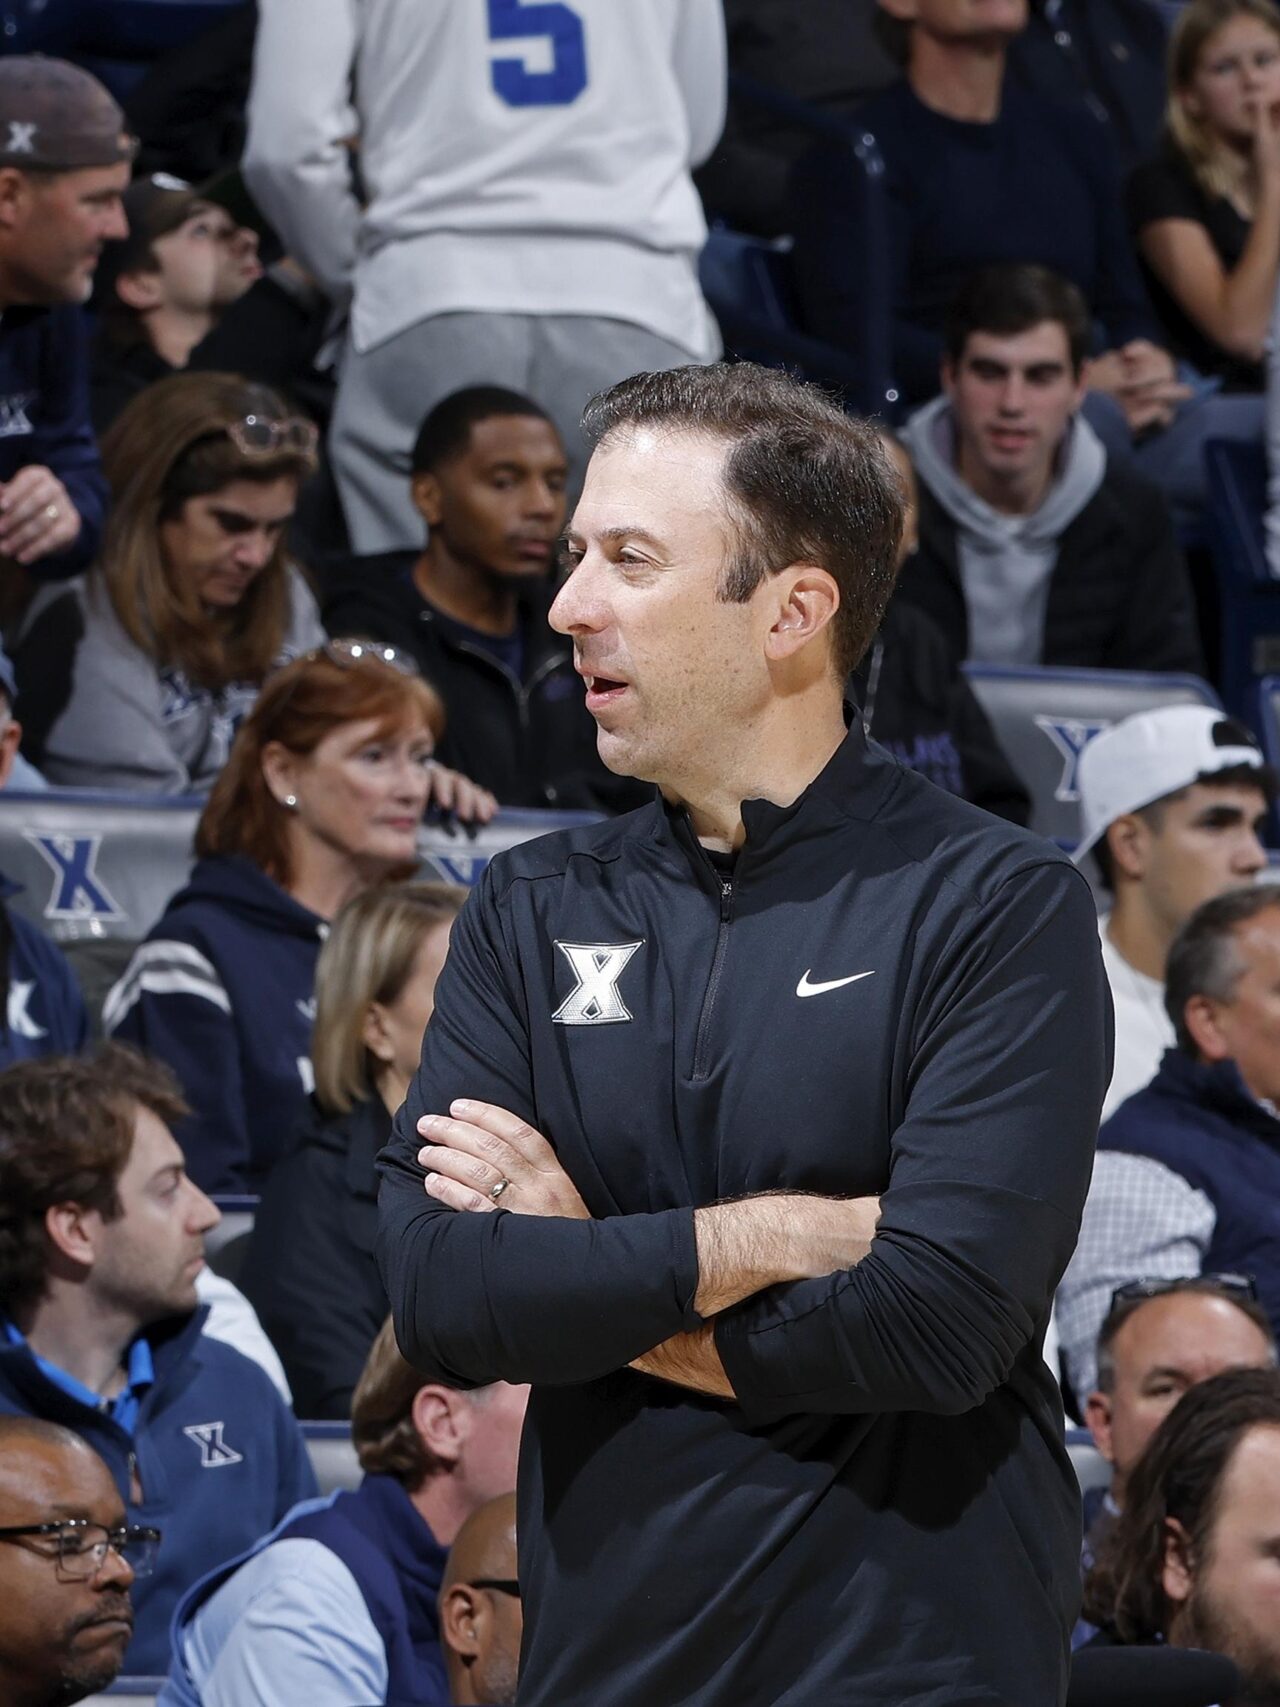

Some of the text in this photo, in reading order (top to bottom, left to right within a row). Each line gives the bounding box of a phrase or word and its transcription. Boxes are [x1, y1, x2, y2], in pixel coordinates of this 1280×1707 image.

[487, 0, 588, 107] 5
[6, 121, 37, 154] X
[21, 829, 130, 921] X
[551, 939, 646, 1026] X
[183, 1421, 243, 1468] X
